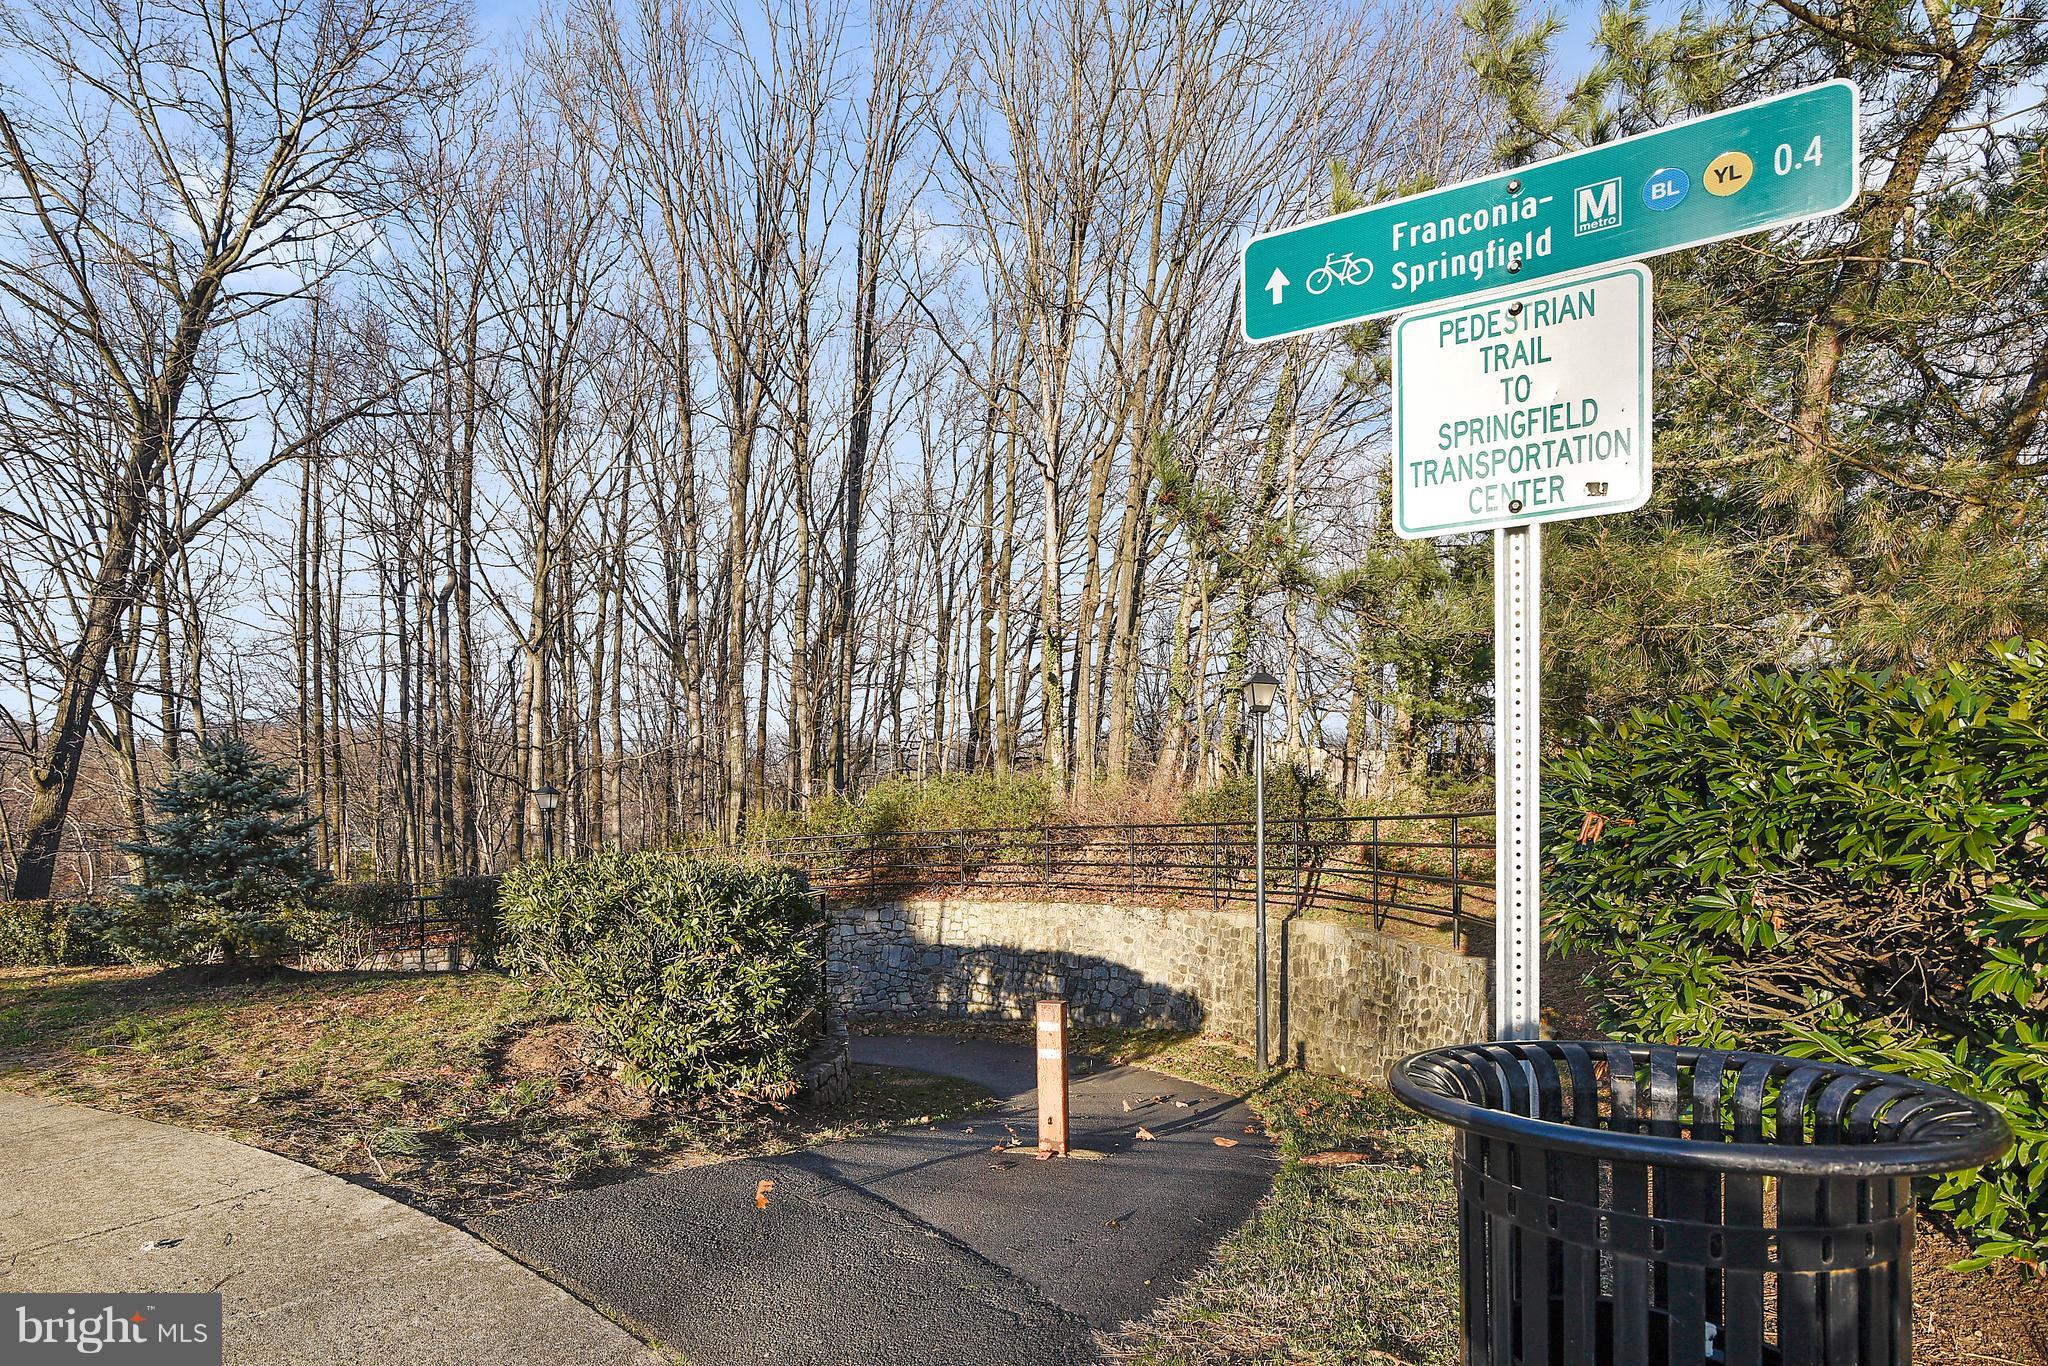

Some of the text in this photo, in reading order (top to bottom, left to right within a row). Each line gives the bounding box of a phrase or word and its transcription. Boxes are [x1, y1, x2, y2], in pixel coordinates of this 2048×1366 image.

[1713, 163, 1744, 184] YL
[1774, 135, 1824, 178] 0.4
[1651, 181, 1680, 202] BL
[1391, 195, 1554, 252] Franconia-
[1579, 215, 1618, 231] metro
[1391, 227, 1552, 293] Springfield
[1439, 289, 1595, 348] PEDESTRIAN
[1480, 336, 1552, 373] TRAIL
[1500, 374, 1531, 405] TO
[1438, 398, 1599, 450] SPRINGFIELD
[1410, 427, 1632, 488] TRANSPORTATION
[1468, 475, 1565, 514] CENTER
